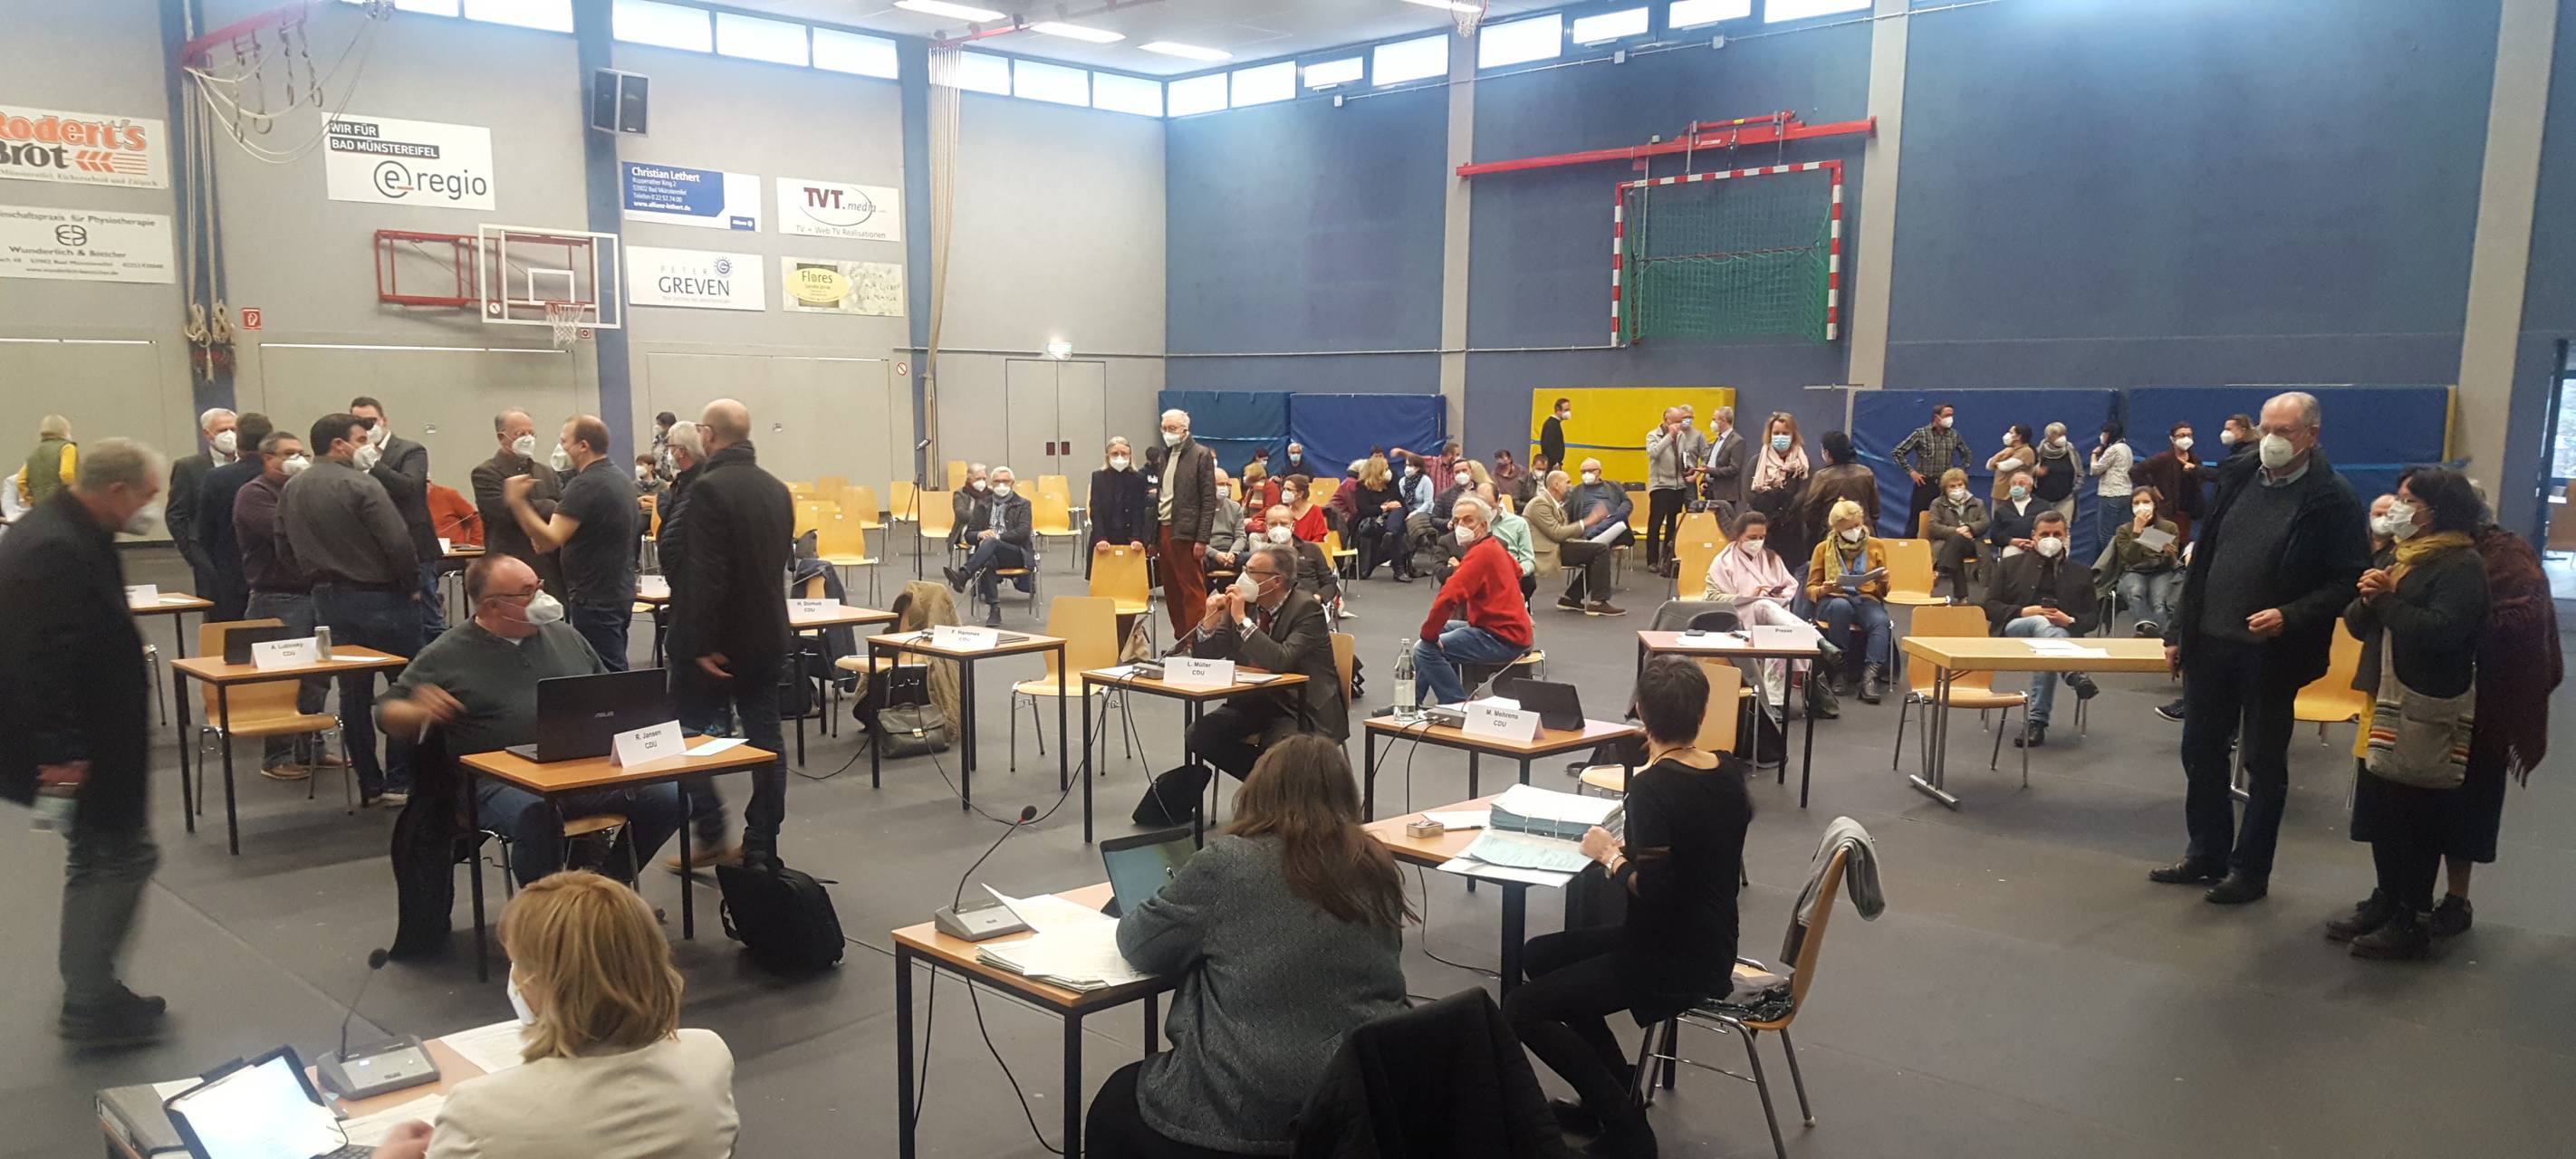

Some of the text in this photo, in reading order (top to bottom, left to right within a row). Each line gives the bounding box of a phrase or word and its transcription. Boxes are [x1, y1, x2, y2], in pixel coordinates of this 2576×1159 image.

[331, 123, 377, 136] WIR FÜR
[332, 139, 438, 158] BAD MÜNSTEREIFEL
[631, 166, 700, 182] Christian Lethert
[802, 270, 833, 283] Flores
[658, 276, 730, 297] GREVEN
[643, 730, 661, 739] Jansen
[645, 741, 657, 749] CDU
